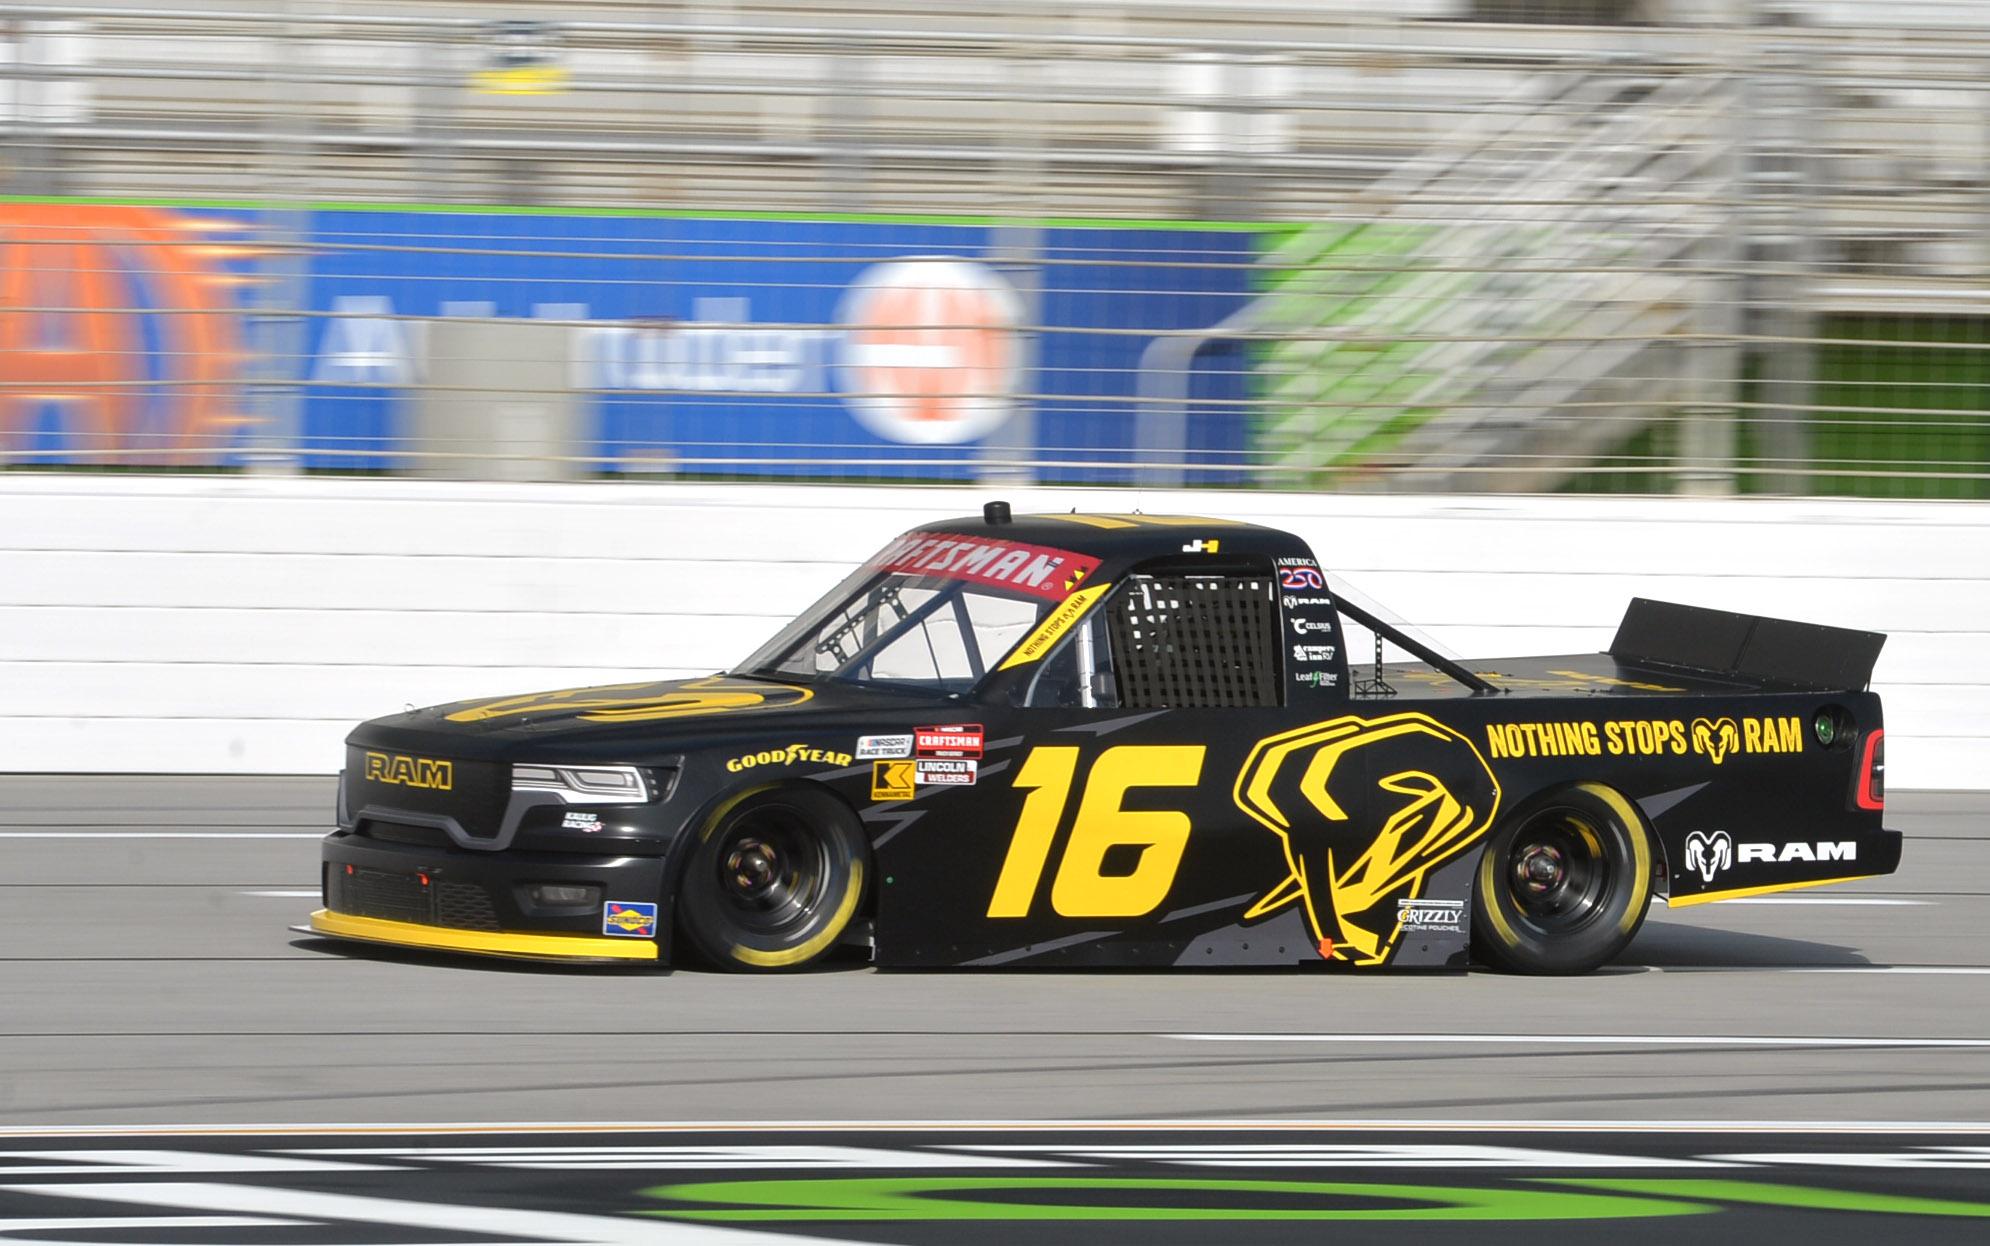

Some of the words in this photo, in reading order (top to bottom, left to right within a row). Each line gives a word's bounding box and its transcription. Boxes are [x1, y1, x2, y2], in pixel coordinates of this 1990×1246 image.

[1277, 557, 1318, 567] AMERICA
[1279, 566, 1323, 590] 250
[1023, 633, 1048, 657] NOTHING
[1045, 615, 1066, 636] STOPS
[1073, 594, 1088, 609] RAM
[918, 736, 981, 747] CRAFTSMAN
[1485, 721, 1602, 758] NOTHING
[1606, 719, 1686, 756] STOPS
[1745, 717, 1803, 753] RAM
[726, 744, 853, 773] GOODYEAR
[860, 747, 881, 756] RACE
[882, 747, 908, 756] TRUCK
[364, 751, 453, 791] RAM
[918, 761, 966, 772] LINCOLN
[927, 773, 971, 783] WELDERS
[986, 745, 1207, 918] 16
[1737, 841, 1857, 863] RAM
[1397, 909, 1463, 924] GRIZZLY
